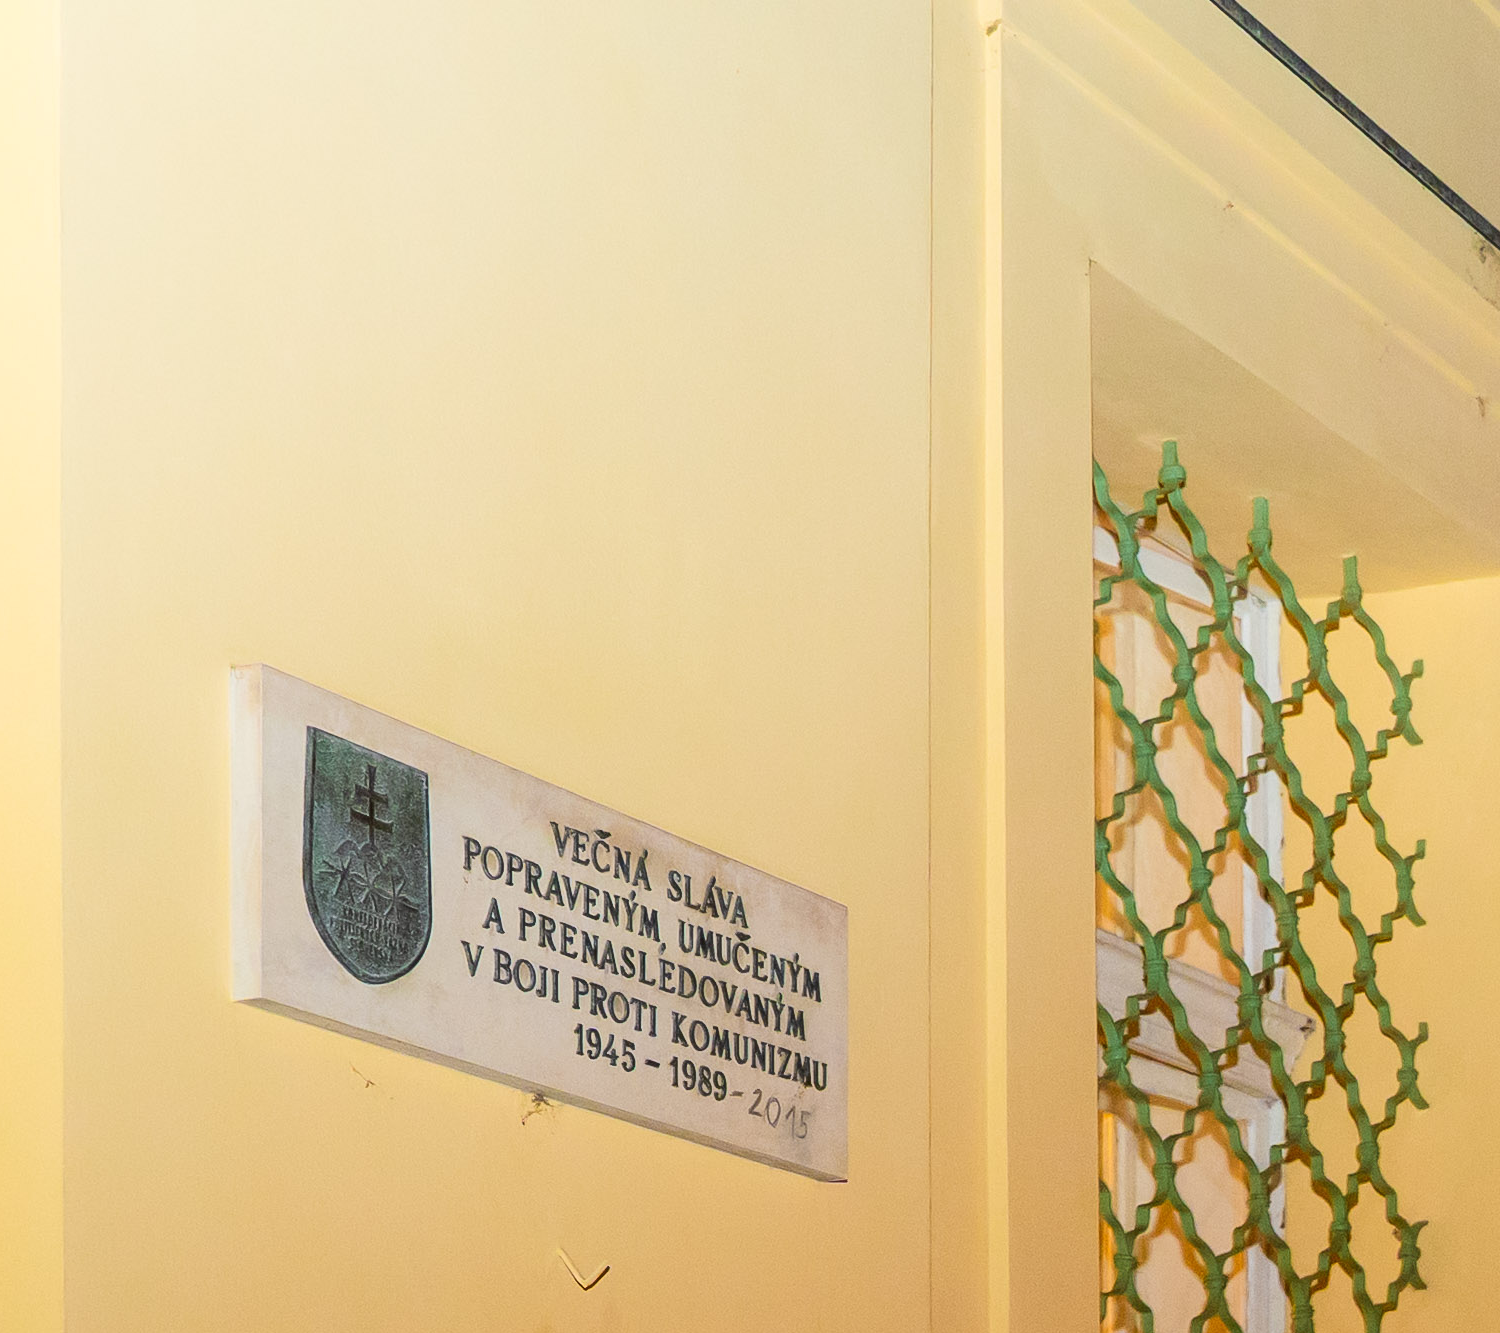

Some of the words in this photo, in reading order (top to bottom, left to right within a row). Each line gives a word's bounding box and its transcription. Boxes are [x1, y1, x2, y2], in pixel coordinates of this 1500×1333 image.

[462, 835, 667, 956] POPRAVENÝM,
[677, 918, 823, 1003] UMUČENÝM
[482, 897, 506, 935] A
[550, 821, 652, 892] VEČNÁ
[666, 869, 749, 929] SLÁVA
[460, 940, 484, 978] V
[493, 948, 560, 1004] BOJI
[571, 976, 658, 1038] PROTI
[671, 1011, 828, 1091] KOMUNIZMU
[573, 1023, 636, 1072] 1945
[669, 1056, 727, 1101] 1989
